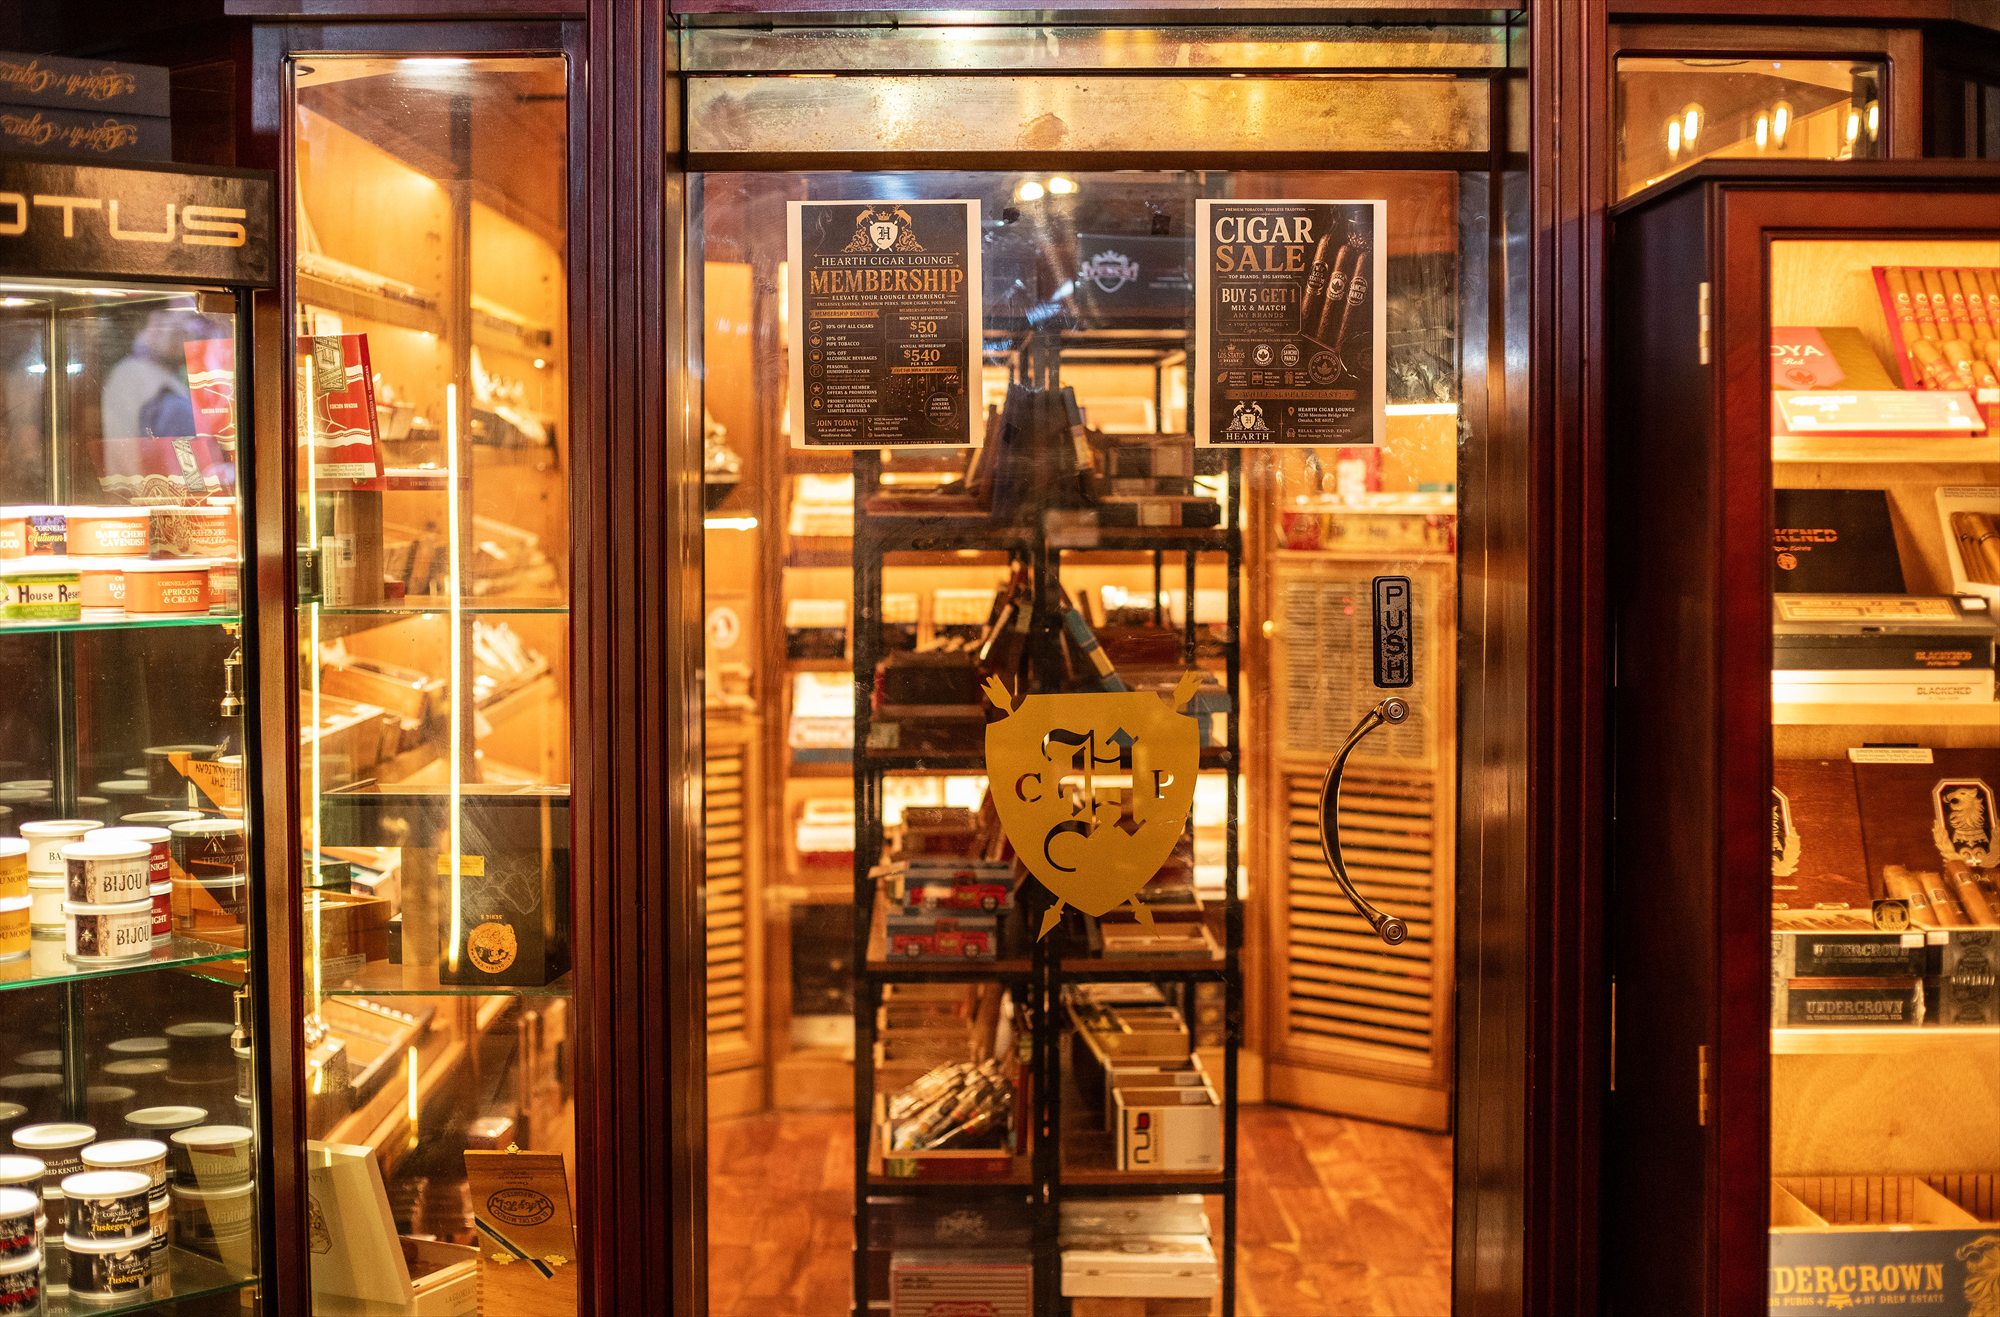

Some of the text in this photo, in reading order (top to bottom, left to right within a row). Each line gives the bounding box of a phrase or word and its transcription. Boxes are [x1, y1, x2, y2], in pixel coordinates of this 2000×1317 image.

[1215, 216, 1314, 244] CIGAR
[821, 256, 954, 266] HEARTH CIGAR LOUNGE
[1215, 245, 1305, 273] SALE
[809, 268, 963, 295] MEMBERSHIP
[1222, 288, 1296, 303] BUY 5 GET 1
[910, 320, 937, 334] $50
[903, 349, 941, 362] $540
[816, 419, 859, 427] JOIN TODAY!
[1226, 432, 1269, 440] HEARTH
[28, 531, 63, 548] Autumn
[17, 584, 54, 603] House
[161, 587, 200, 596] APRICOTS
[171, 596, 198, 604] CREAM
[1386, 586, 1405, 680] PUSH
[1916, 686, 1972, 696] BLACKENED
[1015, 772, 1043, 803] C
[1151, 769, 1174, 799] P
[150, 861, 169, 872] NIGHT
[103, 873, 142, 893] BIJOU
[116, 925, 150, 946] BIJOU
[1806, 1000, 1904, 1014] UNDERCROWN
[91, 1223, 128, 1233] Tuskegee
[107, 1273, 140, 1285] Tuskegee
[1784, 1298, 1814, 1307] PUROS
[1864, 1293, 1944, 1305] BY DREW ESTATE
